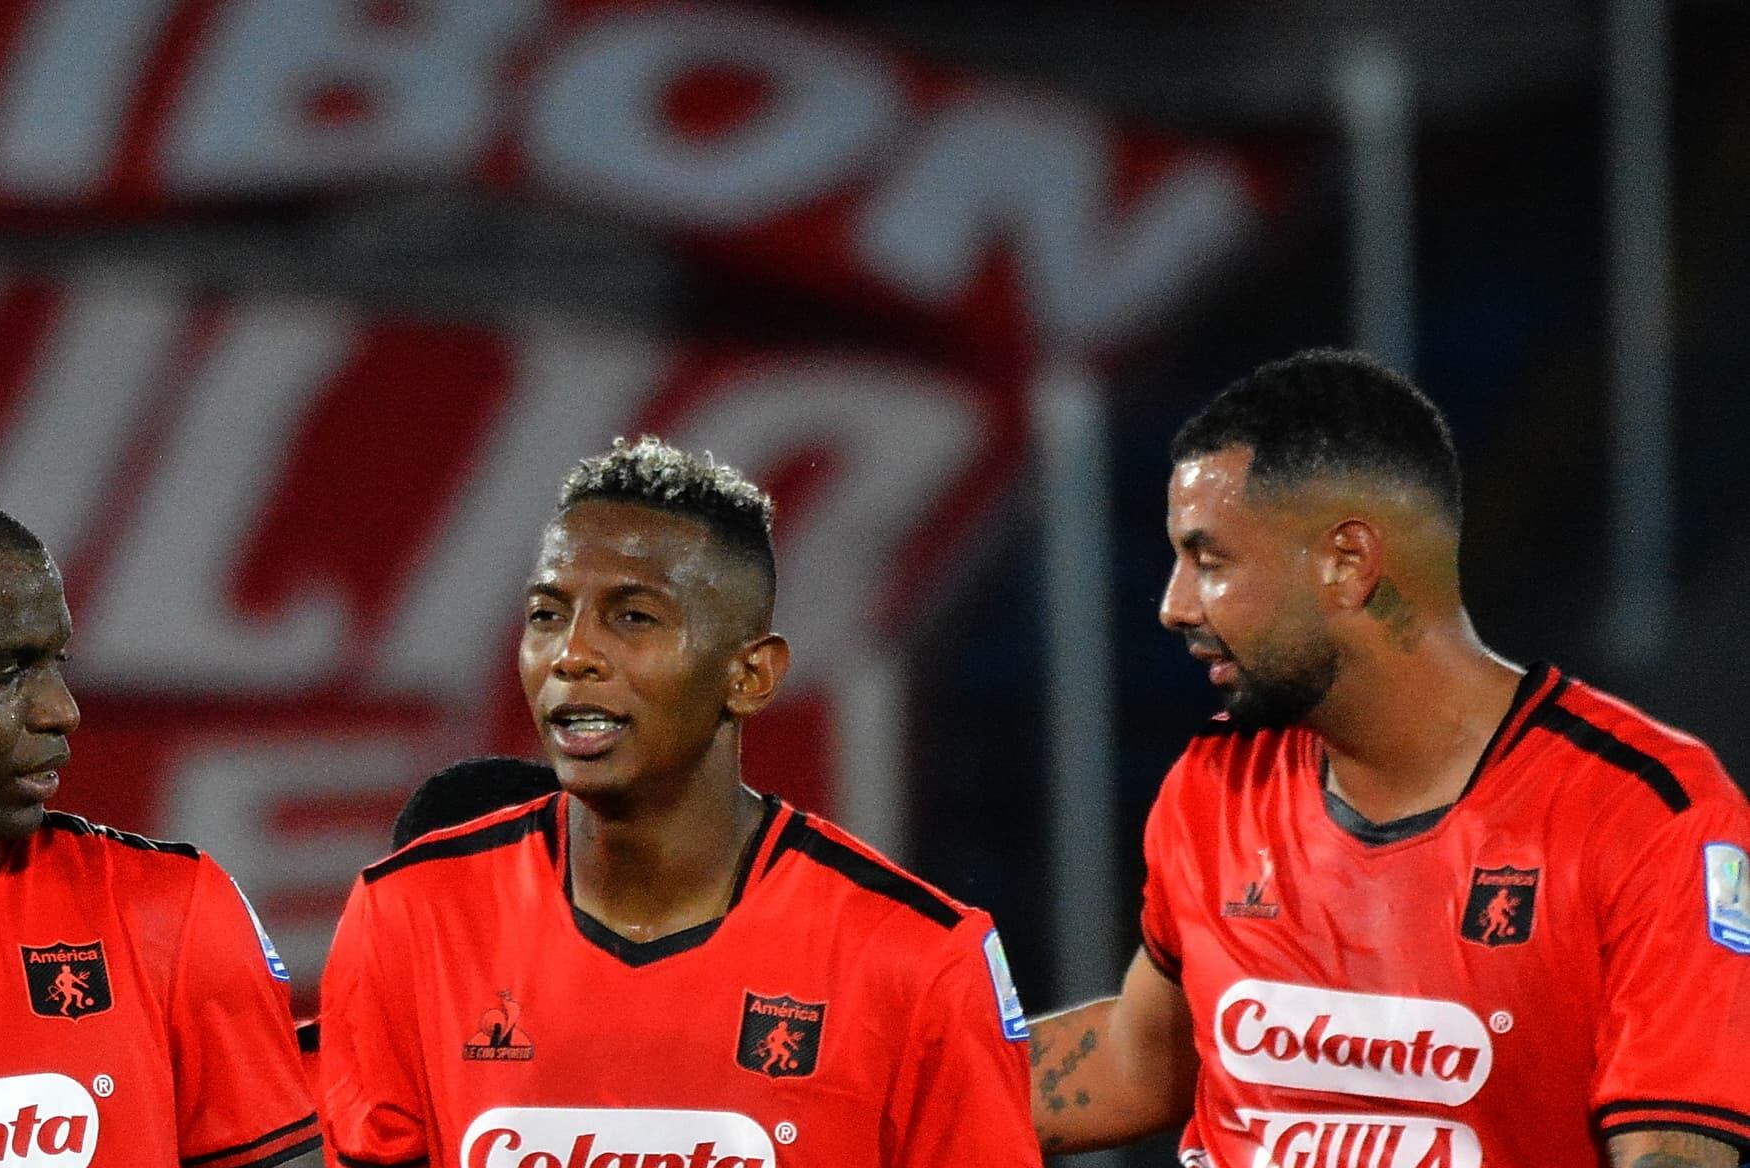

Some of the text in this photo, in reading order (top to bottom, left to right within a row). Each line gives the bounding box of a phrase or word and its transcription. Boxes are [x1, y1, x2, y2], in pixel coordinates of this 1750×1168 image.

[30, 948, 99, 964] América
[750, 1000, 820, 1022] América
[1221, 998, 1481, 1082] Colanta
